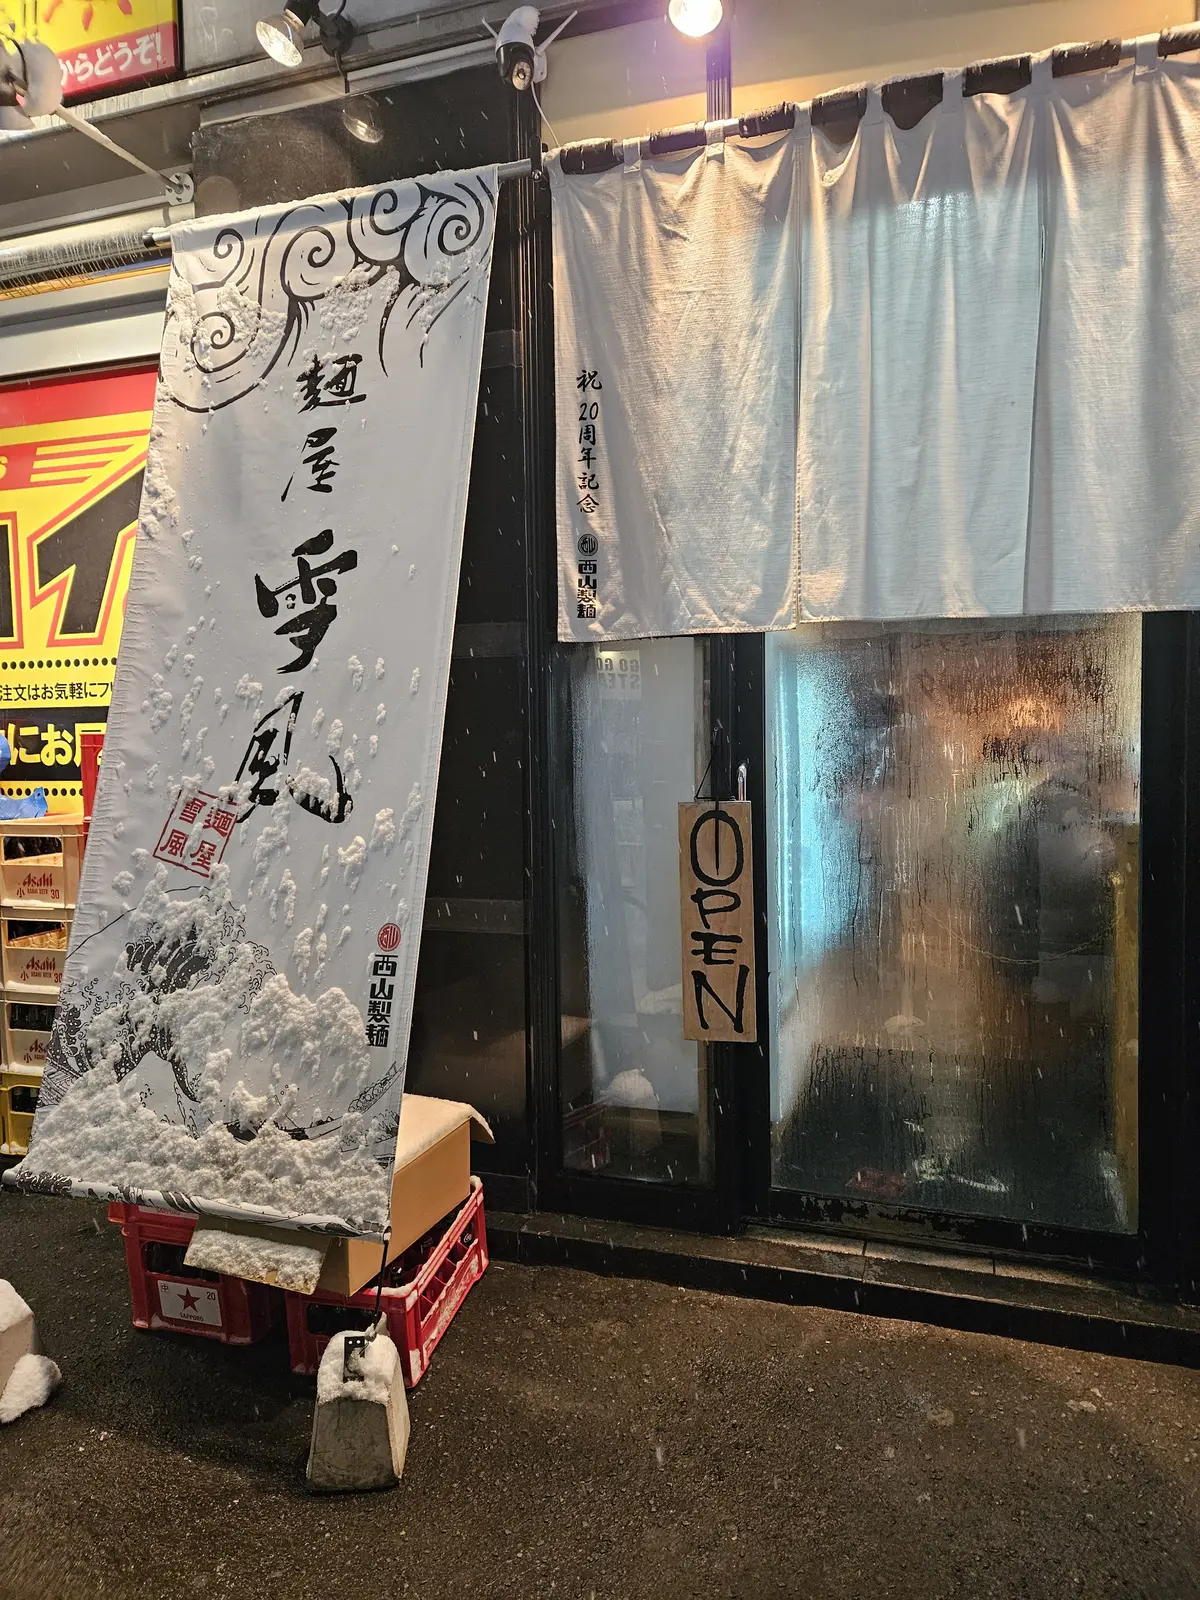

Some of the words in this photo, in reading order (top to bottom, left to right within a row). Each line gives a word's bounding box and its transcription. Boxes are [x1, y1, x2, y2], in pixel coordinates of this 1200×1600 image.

[575, 369, 603, 514] 祝20周年記念
[0, 681, 113, 702] 注文はお気軽にフ
[22, 872, 53, 887] Asahi
[50, 888, 60, 899] 30
[690, 809, 750, 1034] OPEN
[25, 955, 56, 971] Asahi
[206, 1291, 216, 1301] 20
[179, 1312, 204, 1322] SAPPORO
